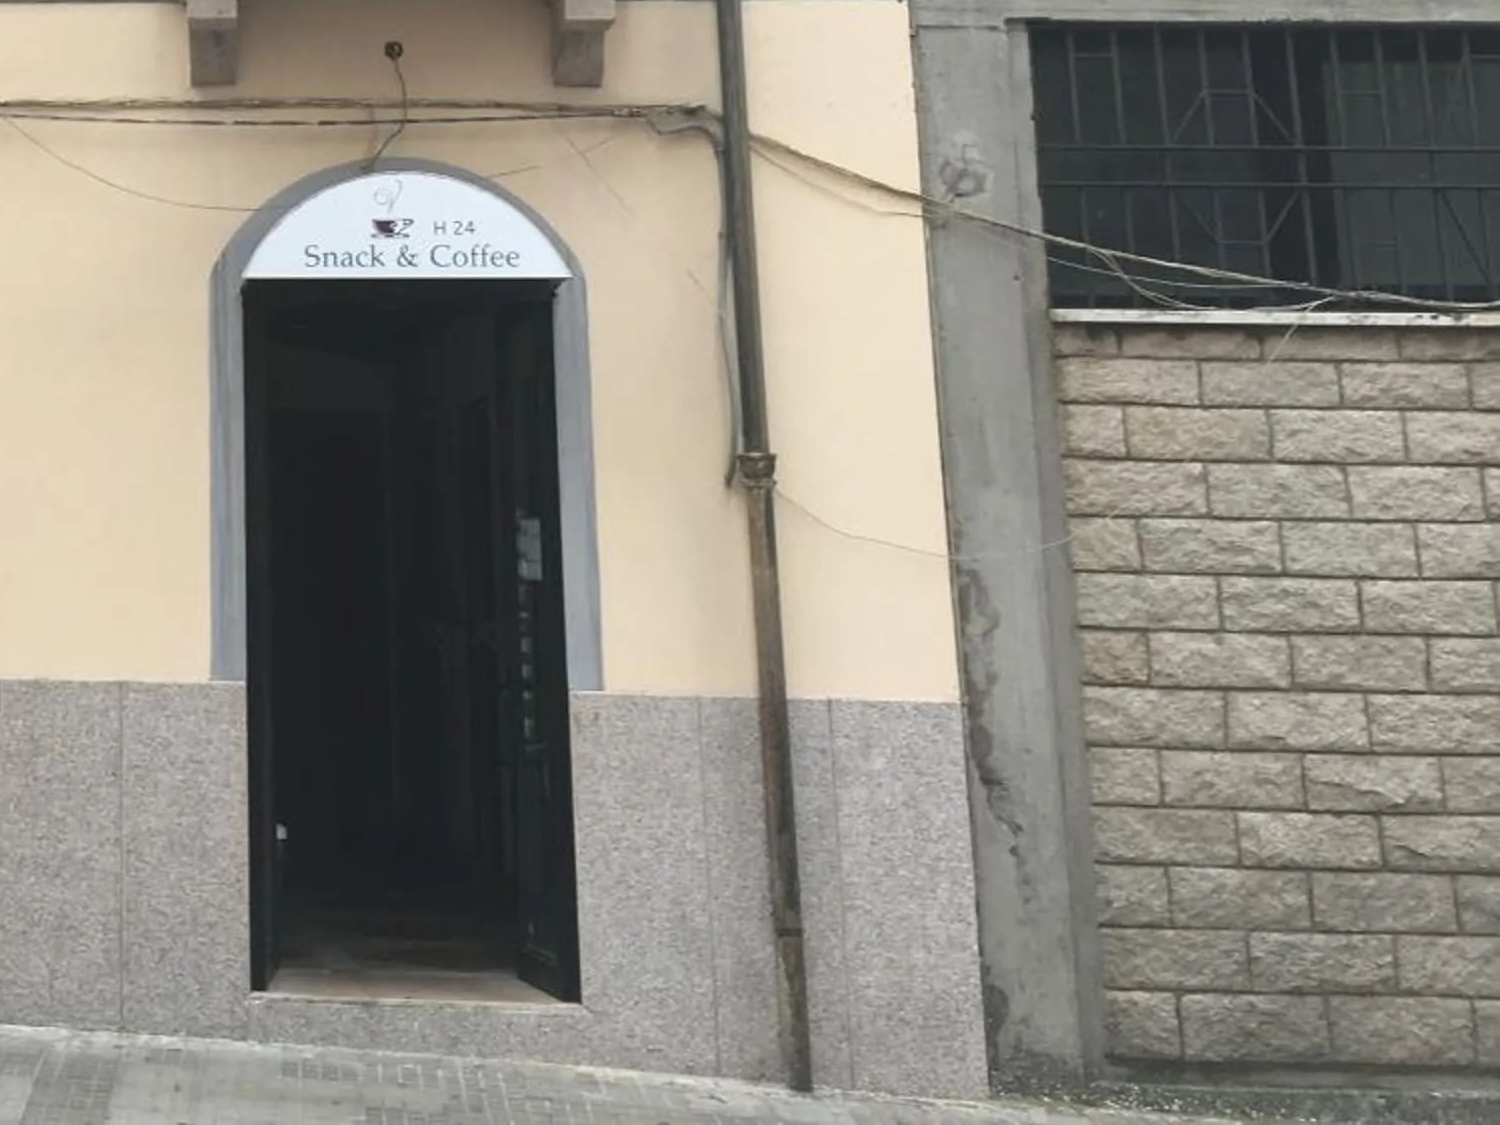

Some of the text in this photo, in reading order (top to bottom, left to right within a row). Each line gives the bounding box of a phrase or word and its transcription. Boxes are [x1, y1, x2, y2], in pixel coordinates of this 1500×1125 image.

[433, 220, 476, 236] H 24
[303, 243, 520, 268] Snack & Coffee
